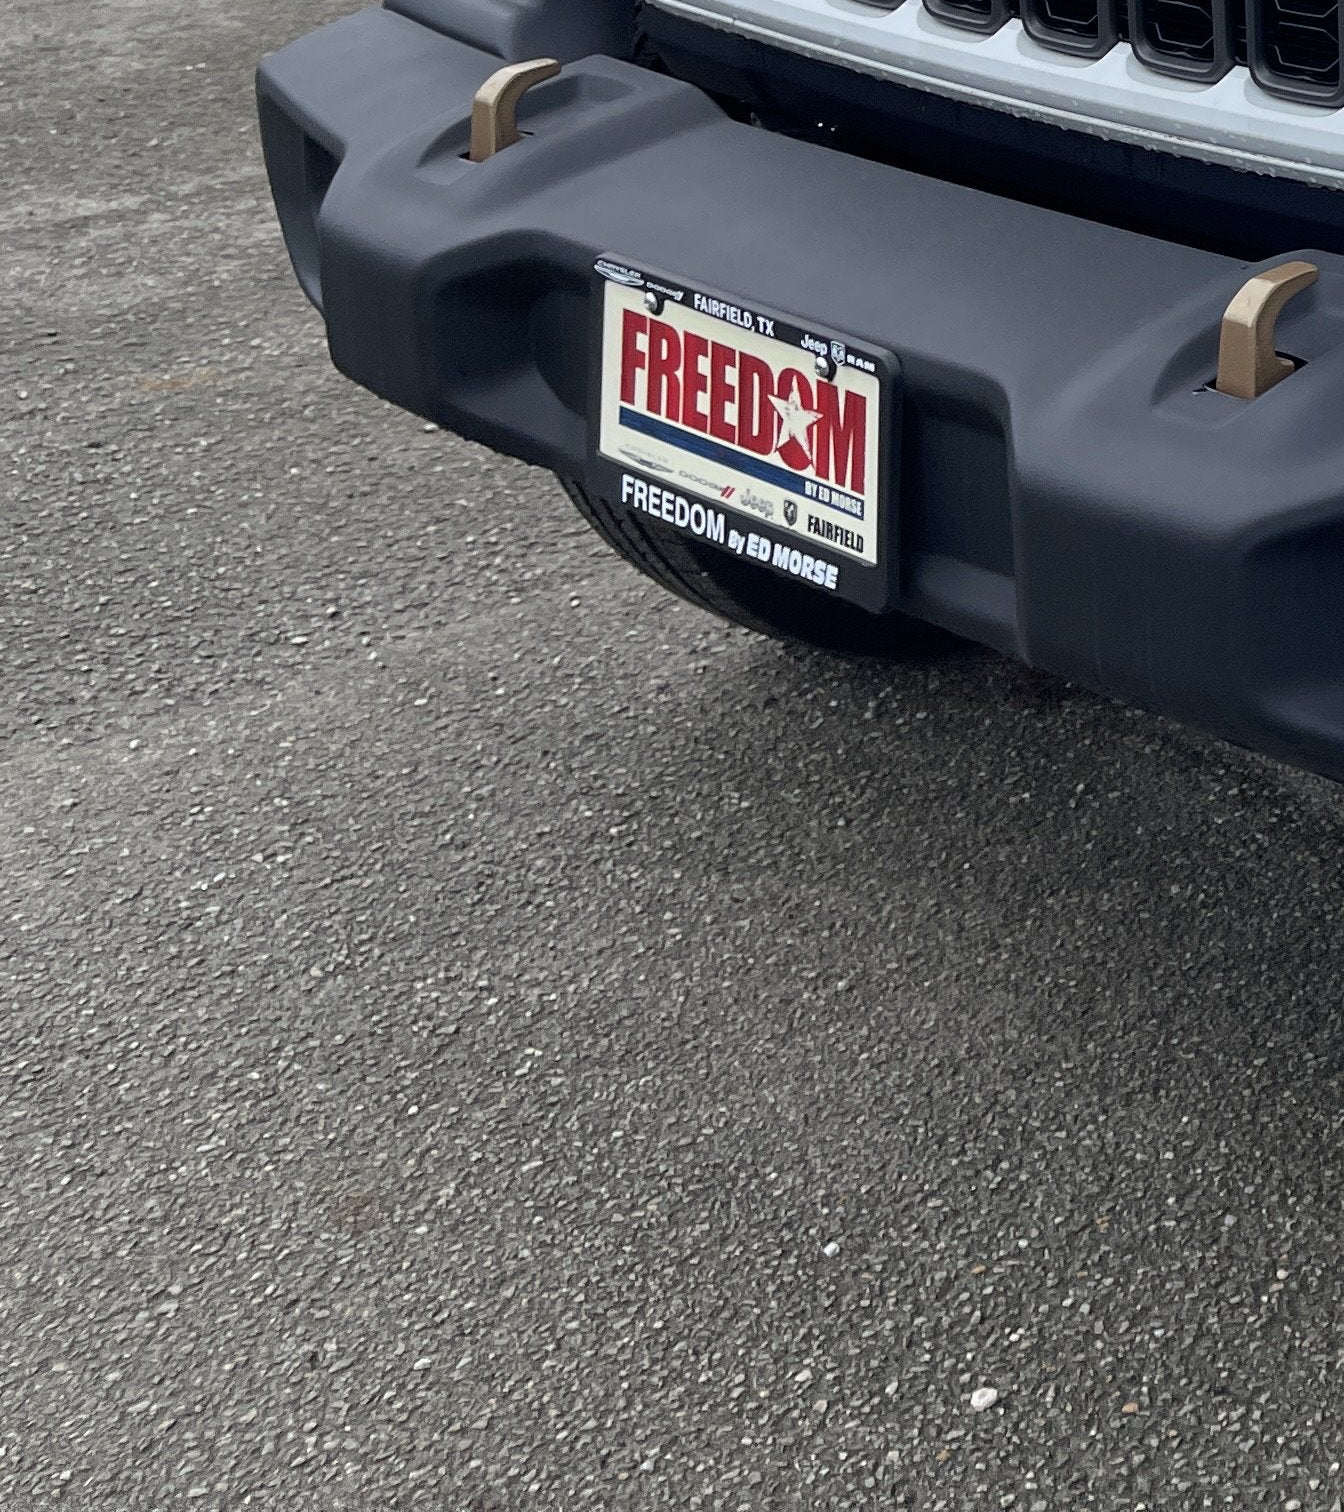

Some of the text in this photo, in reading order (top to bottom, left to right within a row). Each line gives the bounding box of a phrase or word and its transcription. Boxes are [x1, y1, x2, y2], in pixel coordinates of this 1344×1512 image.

[693, 293, 775, 337] FAIRFIELD, TX
[800, 334, 828, 356] Jeep
[619, 308, 867, 496] FREEDOM
[621, 473, 725, 544] FREEDOM
[746, 532, 771, 562] ED
[772, 543, 839, 590] MORSE
[739, 488, 774, 519] Jeep
[807, 513, 864, 554] FAIRFIELD
[831, 491, 862, 517] MORSE
